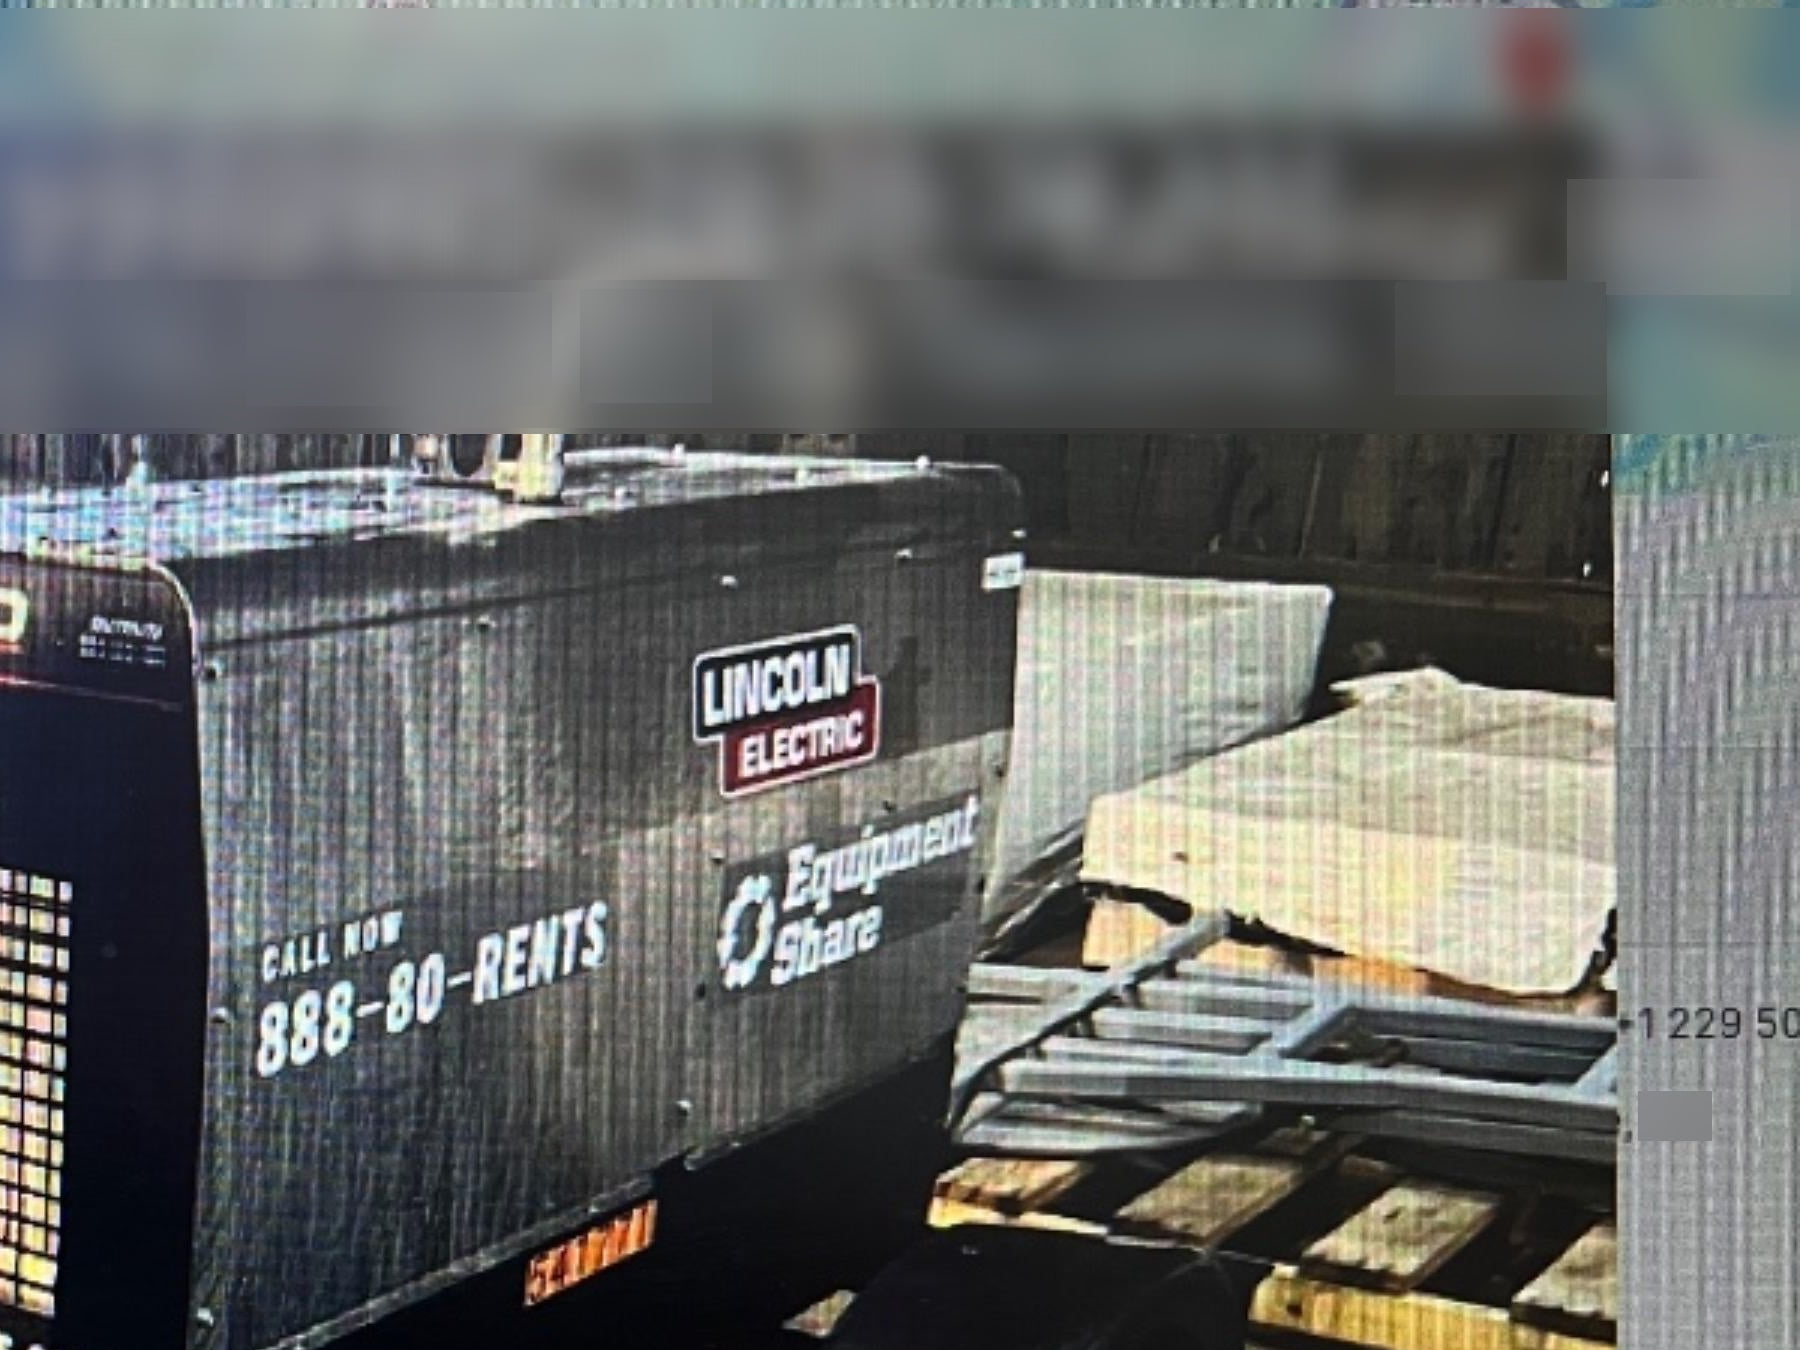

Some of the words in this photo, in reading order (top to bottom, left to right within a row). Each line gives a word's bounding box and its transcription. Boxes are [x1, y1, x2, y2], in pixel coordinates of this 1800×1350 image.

[703, 643, 850, 726] LINCOLN
[738, 710, 865, 779] ELECTRIC
[783, 794, 980, 913] Equipment
[261, 930, 331, 984] CALL
[344, 909, 403, 960] NOW
[770, 904, 883, 986] Share
[256, 900, 608, 1078] 888-80-RENTS
[1667, 1007, 1742, 1039] 229
